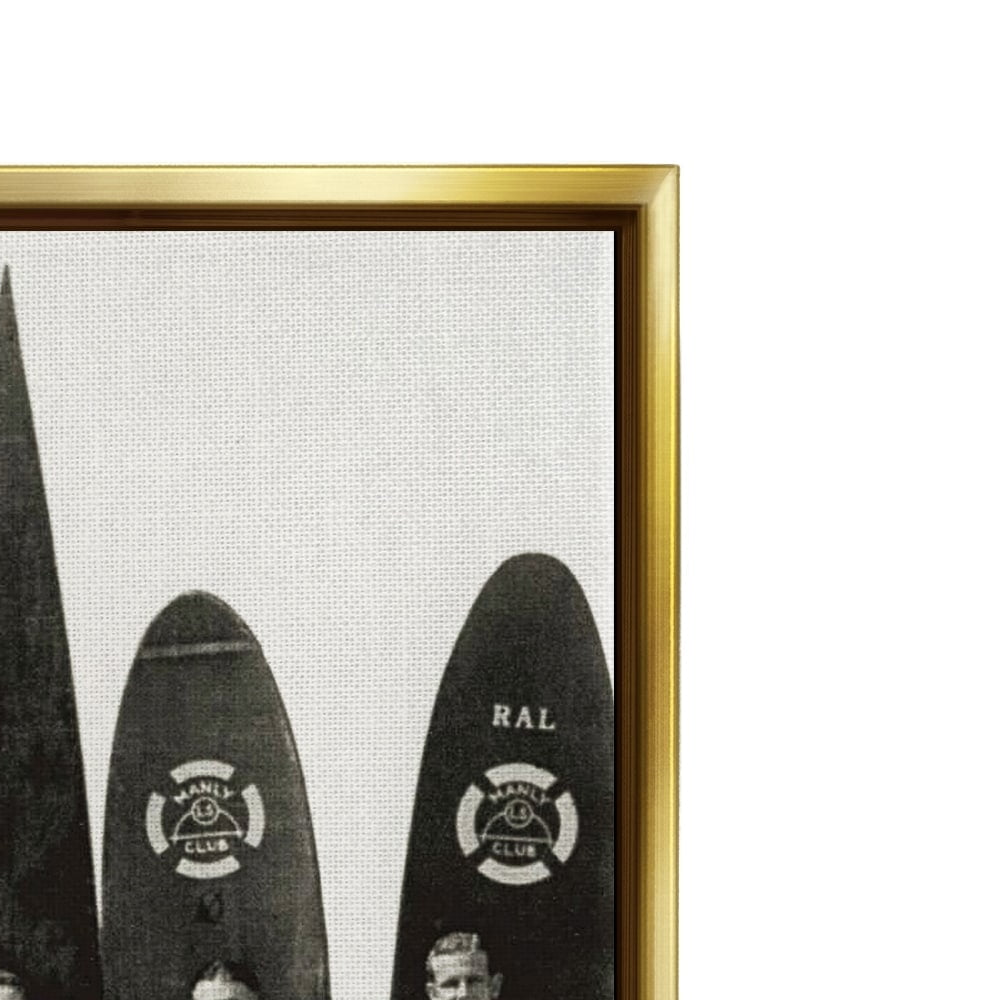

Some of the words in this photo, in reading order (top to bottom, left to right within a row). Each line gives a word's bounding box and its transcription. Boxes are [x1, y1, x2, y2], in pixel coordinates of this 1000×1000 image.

[492, 704, 556, 730] RAL
[174, 780, 235, 804] MANLY
[489, 785, 551, 806] MANLY
[184, 838, 229, 854] CLUB
[492, 842, 536, 858] CLUB
